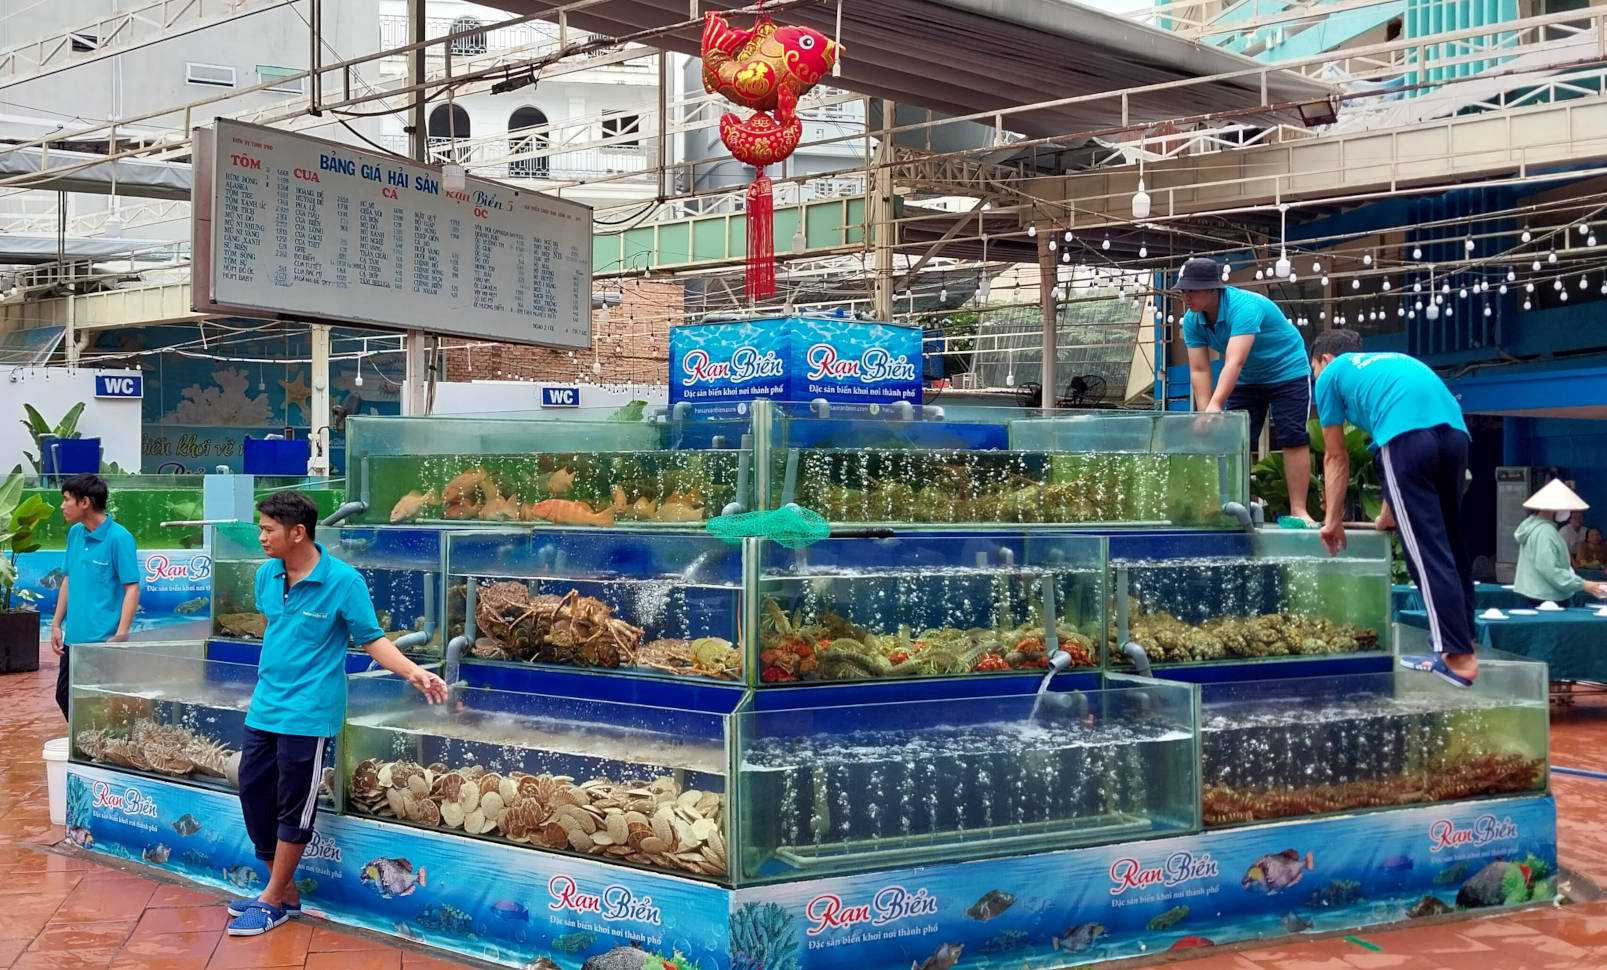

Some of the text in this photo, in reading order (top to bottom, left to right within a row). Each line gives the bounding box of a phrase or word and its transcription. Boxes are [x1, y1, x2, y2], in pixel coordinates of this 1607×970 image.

[231, 153, 261, 170] TÔM
[294, 168, 320, 182] CUA
[320, 151, 438, 195] BẢNG GIÁ HẢI SẢN
[382, 187, 398, 200] CÁ
[474, 206, 488, 219] ỐC
[682, 346, 784, 386] Rạn Biển
[807, 343, 916, 383] Rạn Biển
[104, 378, 134, 394] WC
[550, 390, 574, 404] WC
[750, 386, 769, 394] thành
[770, 384, 784, 395] phố
[809, 384, 822, 394] Đặc
[824, 386, 836, 394] sản
[836, 386, 852, 394] biển
[882, 388, 901, 396] thành
[902, 388, 916, 398] phố
[146, 554, 188, 582] Rạn
[93, 781, 158, 818] Rạn Biển
[1430, 814, 1518, 852] Rạn Biển
[1110, 850, 1218, 895] Rạn Biển
[549, 875, 662, 926] Rạn Biển
[807, 886, 938, 936] Rạn Biển
[576, 919, 592, 930] biển
[594, 922, 610, 934] khơi
[624, 930, 646, 942] thành
[647, 934, 662, 946] phố
[808, 922, 938, 950] Đặc sản biển khơi nơi thành phố
